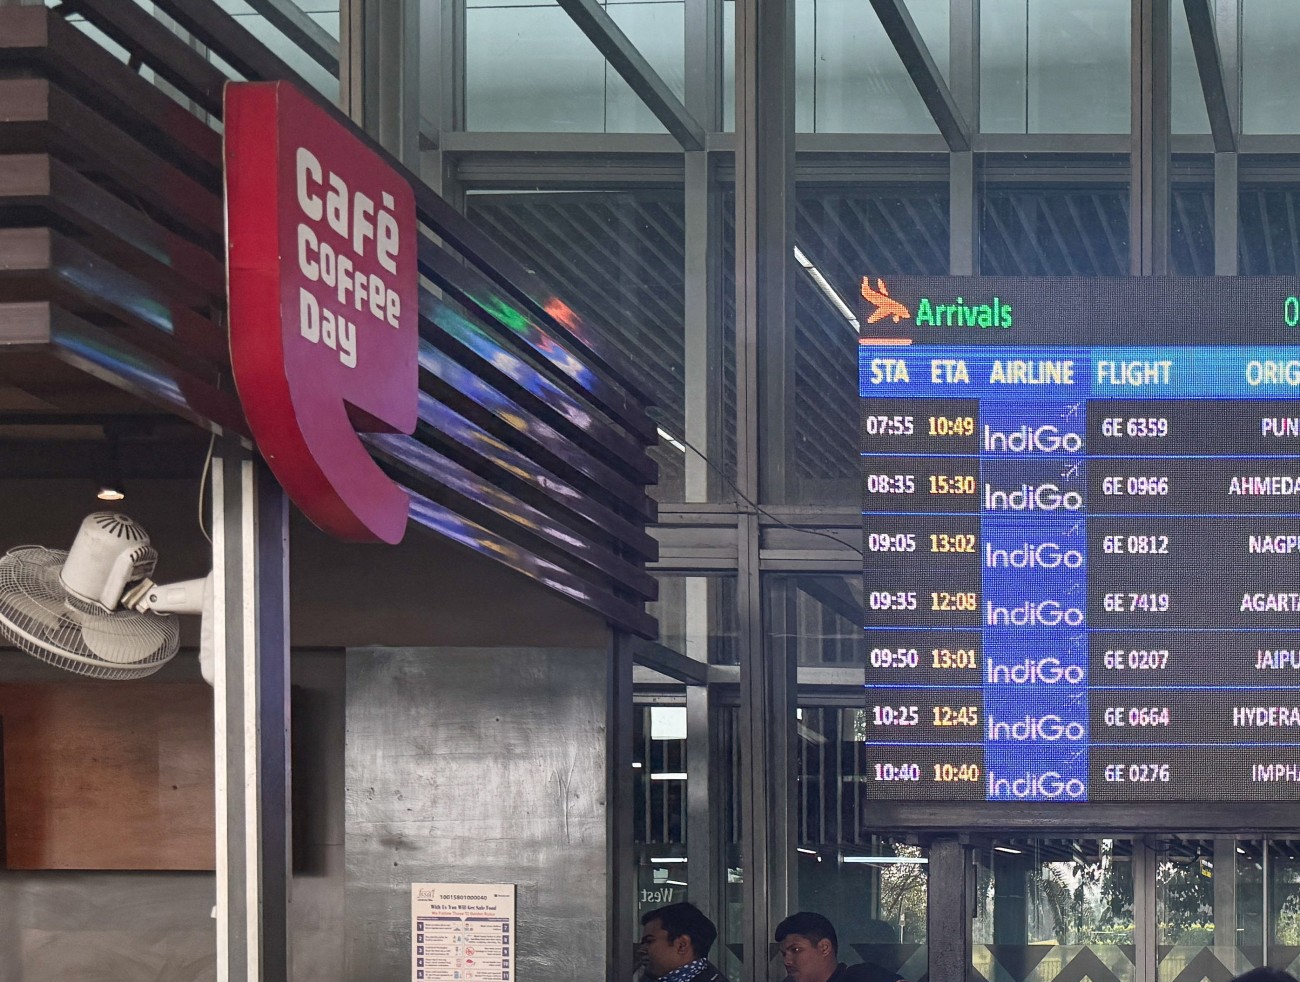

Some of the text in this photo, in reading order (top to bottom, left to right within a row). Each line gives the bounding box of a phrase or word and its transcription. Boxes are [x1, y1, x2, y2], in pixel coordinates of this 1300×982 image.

[299, 286, 357, 369] Day
[916, 297, 1013, 329] Arrivals
[870, 358, 910, 384] STA
[931, 361, 970, 384] ETA
[989, 361, 1074, 385] AIRLINE
[1097, 361, 1172, 386] FLIGHT
[866, 416, 914, 436] 07:55
[928, 416, 974, 436] 10:49
[984, 424, 1082, 453] IndiGo
[1101, 418, 1122, 438] 6E
[1127, 418, 1168, 438] 6359
[866, 475, 915, 494] 08:35
[929, 475, 975, 495] 15:30
[984, 483, 1082, 511] IndiGo
[1102, 477, 1123, 496] 6E
[1127, 477, 1168, 496] 0966
[868, 534, 916, 553] 09:05
[929, 534, 975, 554] 13:02
[986, 543, 1083, 569] IndiGo
[1103, 536, 1123, 555] 6E
[1128, 536, 1169, 555] 0812
[869, 592, 917, 611] 09:35
[930, 592, 977, 612] 12:08
[986, 600, 1084, 627] IndiGo
[1103, 594, 1123, 612] 6E
[1129, 594, 1169, 612] 7419
[870, 649, 919, 669] 09:50
[931, 649, 977, 669] 13:01
[987, 657, 1084, 684] IndiGo
[1103, 650, 1124, 669] 6E
[1128, 650, 1169, 669] 0207
[872, 706, 919, 726] 10:25
[932, 706, 978, 726] 12:45
[988, 714, 1085, 741] IndiGo
[1104, 708, 1124, 727] 6E
[1128, 708, 1170, 727] 0664
[874, 764, 920, 782] 10:40
[933, 764, 980, 782] 10:40
[989, 771, 1085, 798] IndiGo
[1104, 764, 1124, 782] 6E
[1129, 764, 1170, 782] 0276
